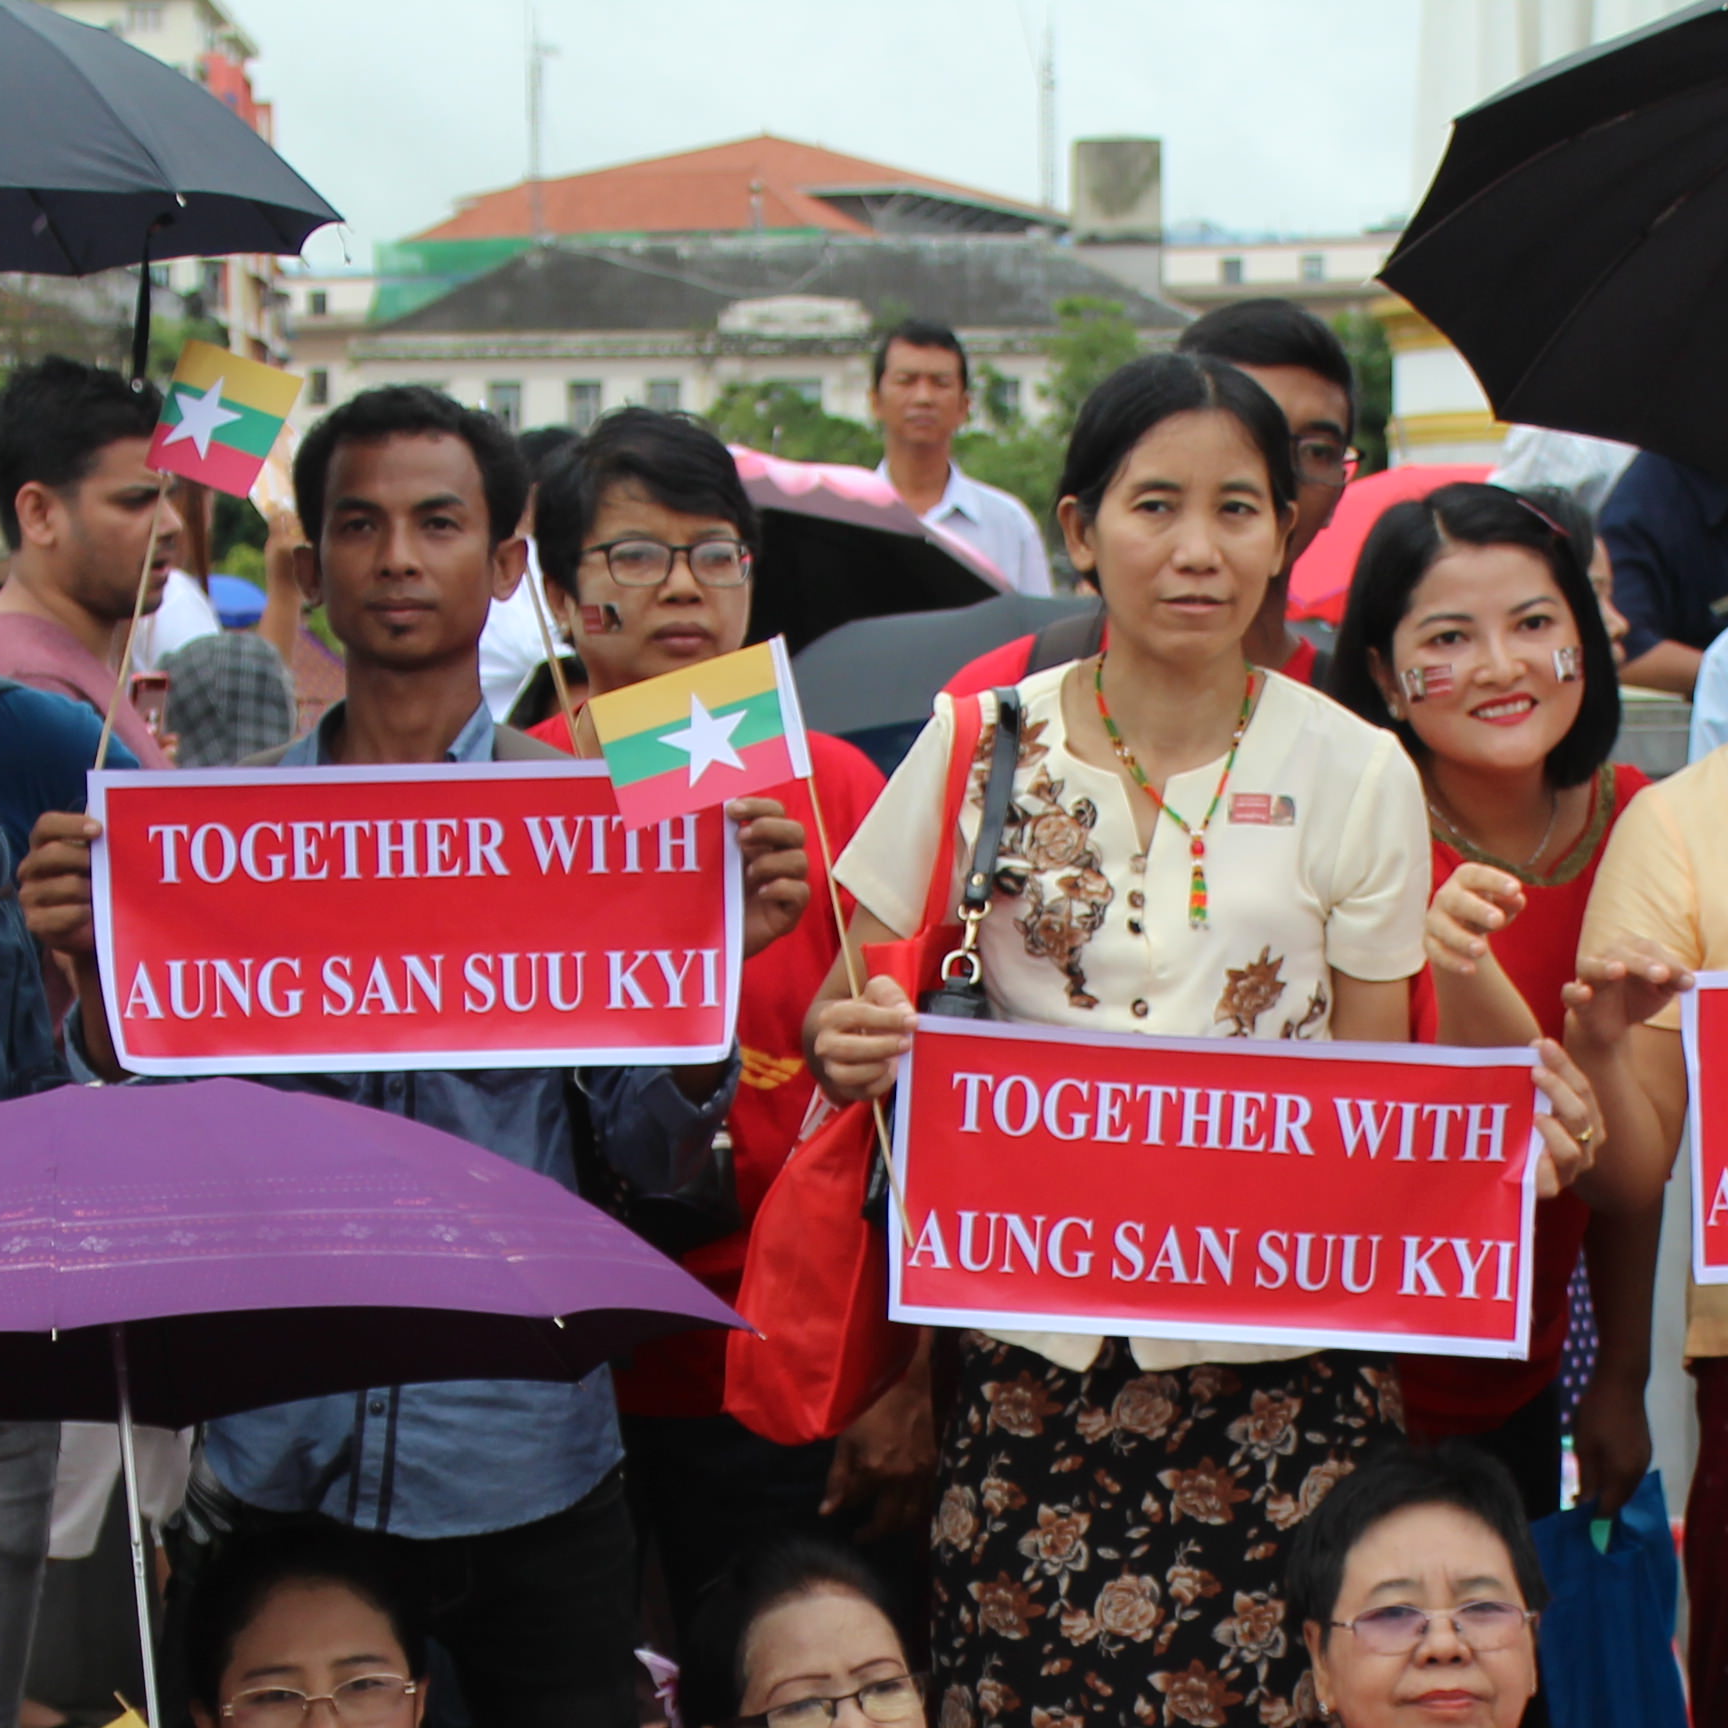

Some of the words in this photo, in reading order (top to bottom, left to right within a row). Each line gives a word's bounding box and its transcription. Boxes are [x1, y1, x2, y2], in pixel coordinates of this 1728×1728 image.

[149, 818, 509, 882] TOGETHER
[524, 813, 699, 874] WITH
[124, 958, 303, 1018] AUNG
[323, 955, 443, 1015] SAN
[465, 952, 585, 1012] SUU
[607, 949, 720, 1008] KYI
[954, 1073, 1313, 1154] TOGETHER
[1334, 1098, 1508, 1161] WITH
[908, 1210, 1093, 1277] AUNG
[1113, 1222, 1239, 1284] SAN
[1256, 1231, 1381, 1292] SUU
[1400, 1237, 1514, 1300] KYI
